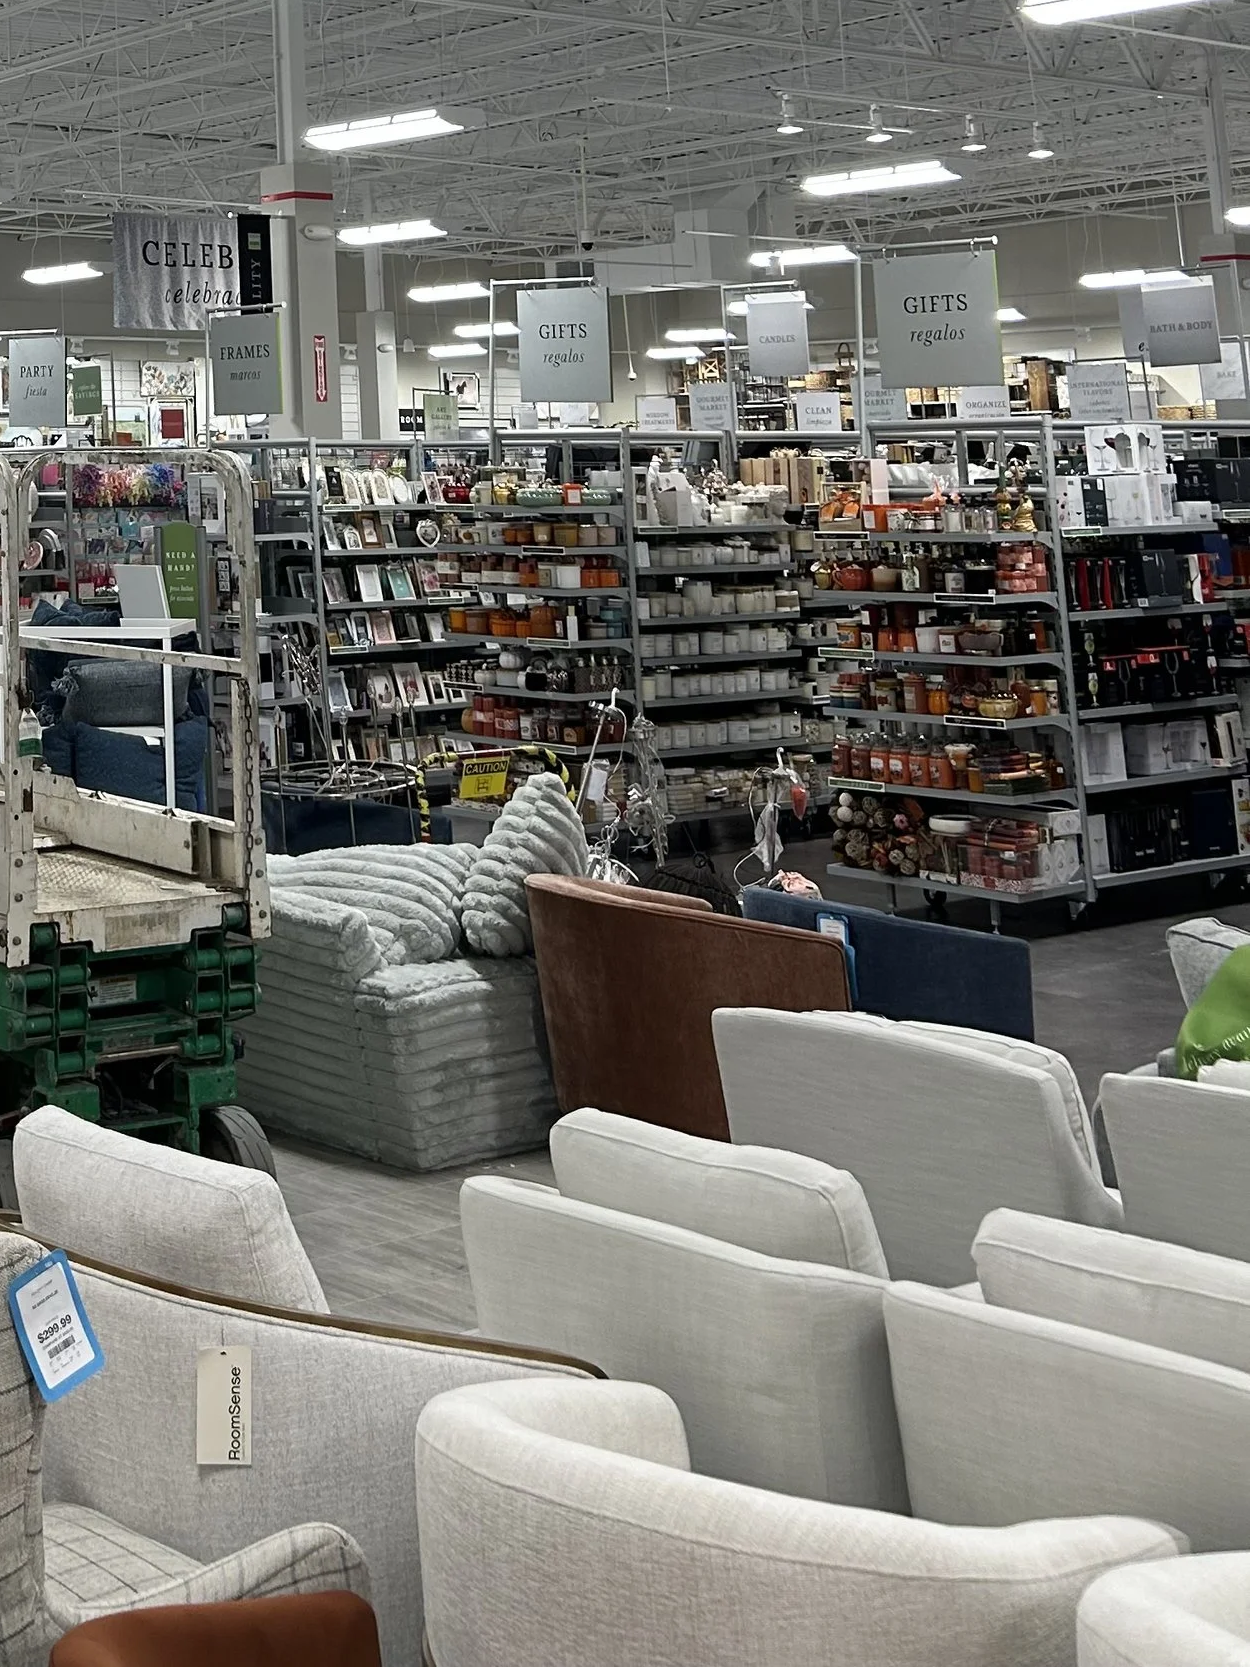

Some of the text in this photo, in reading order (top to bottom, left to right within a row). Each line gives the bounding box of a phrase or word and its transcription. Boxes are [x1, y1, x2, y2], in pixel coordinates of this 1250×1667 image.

[141, 240, 234, 269] CELEB
[251, 258, 262, 301] LITY
[903, 293, 968, 314] GIFTS
[538, 323, 587, 339] GIFTS
[1150, 322, 1176, 333] BATH
[1186, 320, 1214, 331] BODY
[759, 335, 796, 344] CANDLES
[910, 323, 966, 347] regalos
[220, 344, 270, 360] FRAMES
[543, 348, 585, 367] regalos
[20, 365, 54, 378] PARTY
[230, 370, 261, 381] marcos
[23, 384, 48, 400] fiesta
[805, 407, 832, 416] CLEAN
[965, 400, 1007, 409] ORGANIZE
[465, 762, 507, 774] CAUTION
[37, 1314, 72, 1344] $299.99
[228, 1365, 241, 1461] RoomSense
